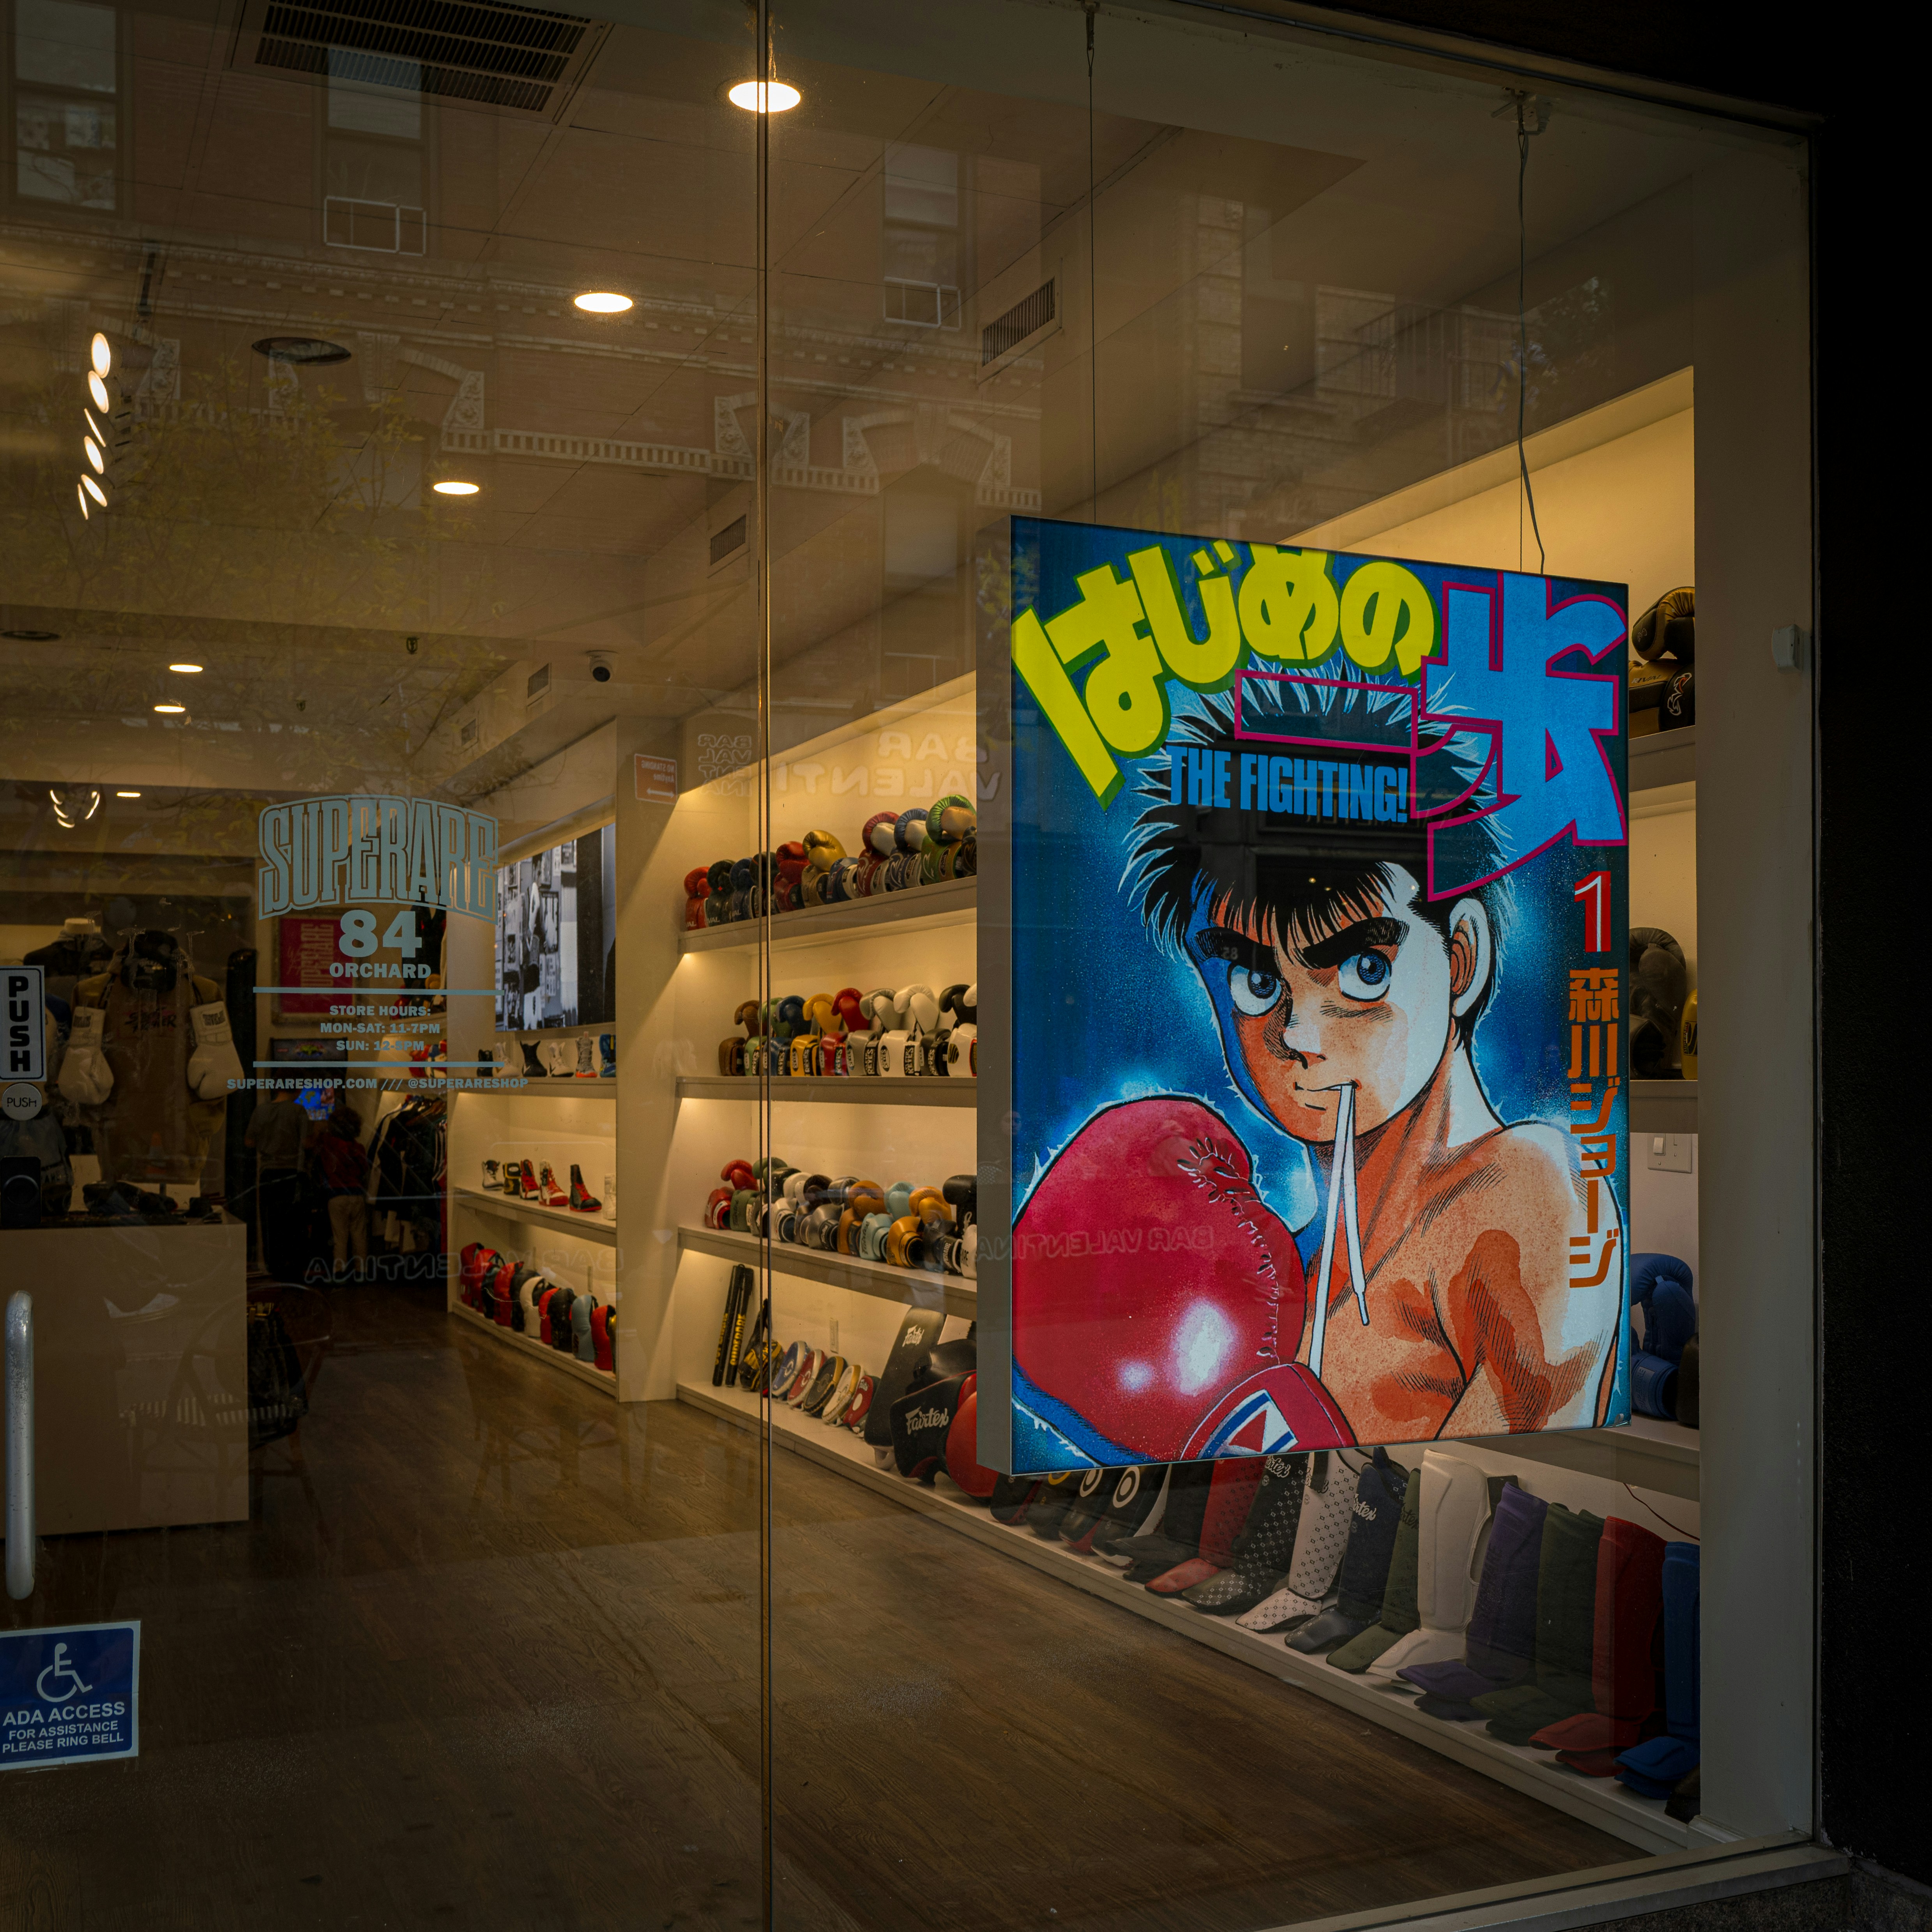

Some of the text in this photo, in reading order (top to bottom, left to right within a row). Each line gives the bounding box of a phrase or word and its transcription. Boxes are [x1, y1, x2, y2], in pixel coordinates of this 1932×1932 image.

[1631, 673, 1662, 684] RIVAL
[1166, 746, 1230, 809] THE
[1241, 752, 1408, 823] FIGHTING!
[259, 795, 498, 925] SUPERARE
[1574, 870, 1612, 953] 1
[339, 910, 422, 958] 84
[329, 963, 431, 979] ORCHARD
[329, 1005, 431, 1016] STORE HOURS:
[9, 976, 30, 1071] PUSH
[320, 1023, 440, 1034] MON-SAT: 11-7PM
[336, 1041, 369, 1051] SUN:
[374, 1041, 424, 1051] 12-5PM
[227, 1078, 377, 1090] SUPERARESHOP.COM
[408, 1078, 529, 1089] @SUPERARESHOP
[7, 1098, 37, 1108] PUSH
[1568, 968, 1621, 1289] 森川ジョージ
[905, 1406, 949, 1435] Fairtex
[2, 1702, 125, 1726] ADA ACCESS
[9, 1720, 118, 1740] FOR ASSISTANCE
[2, 1732, 124, 1753] PLEASE RING BELL
